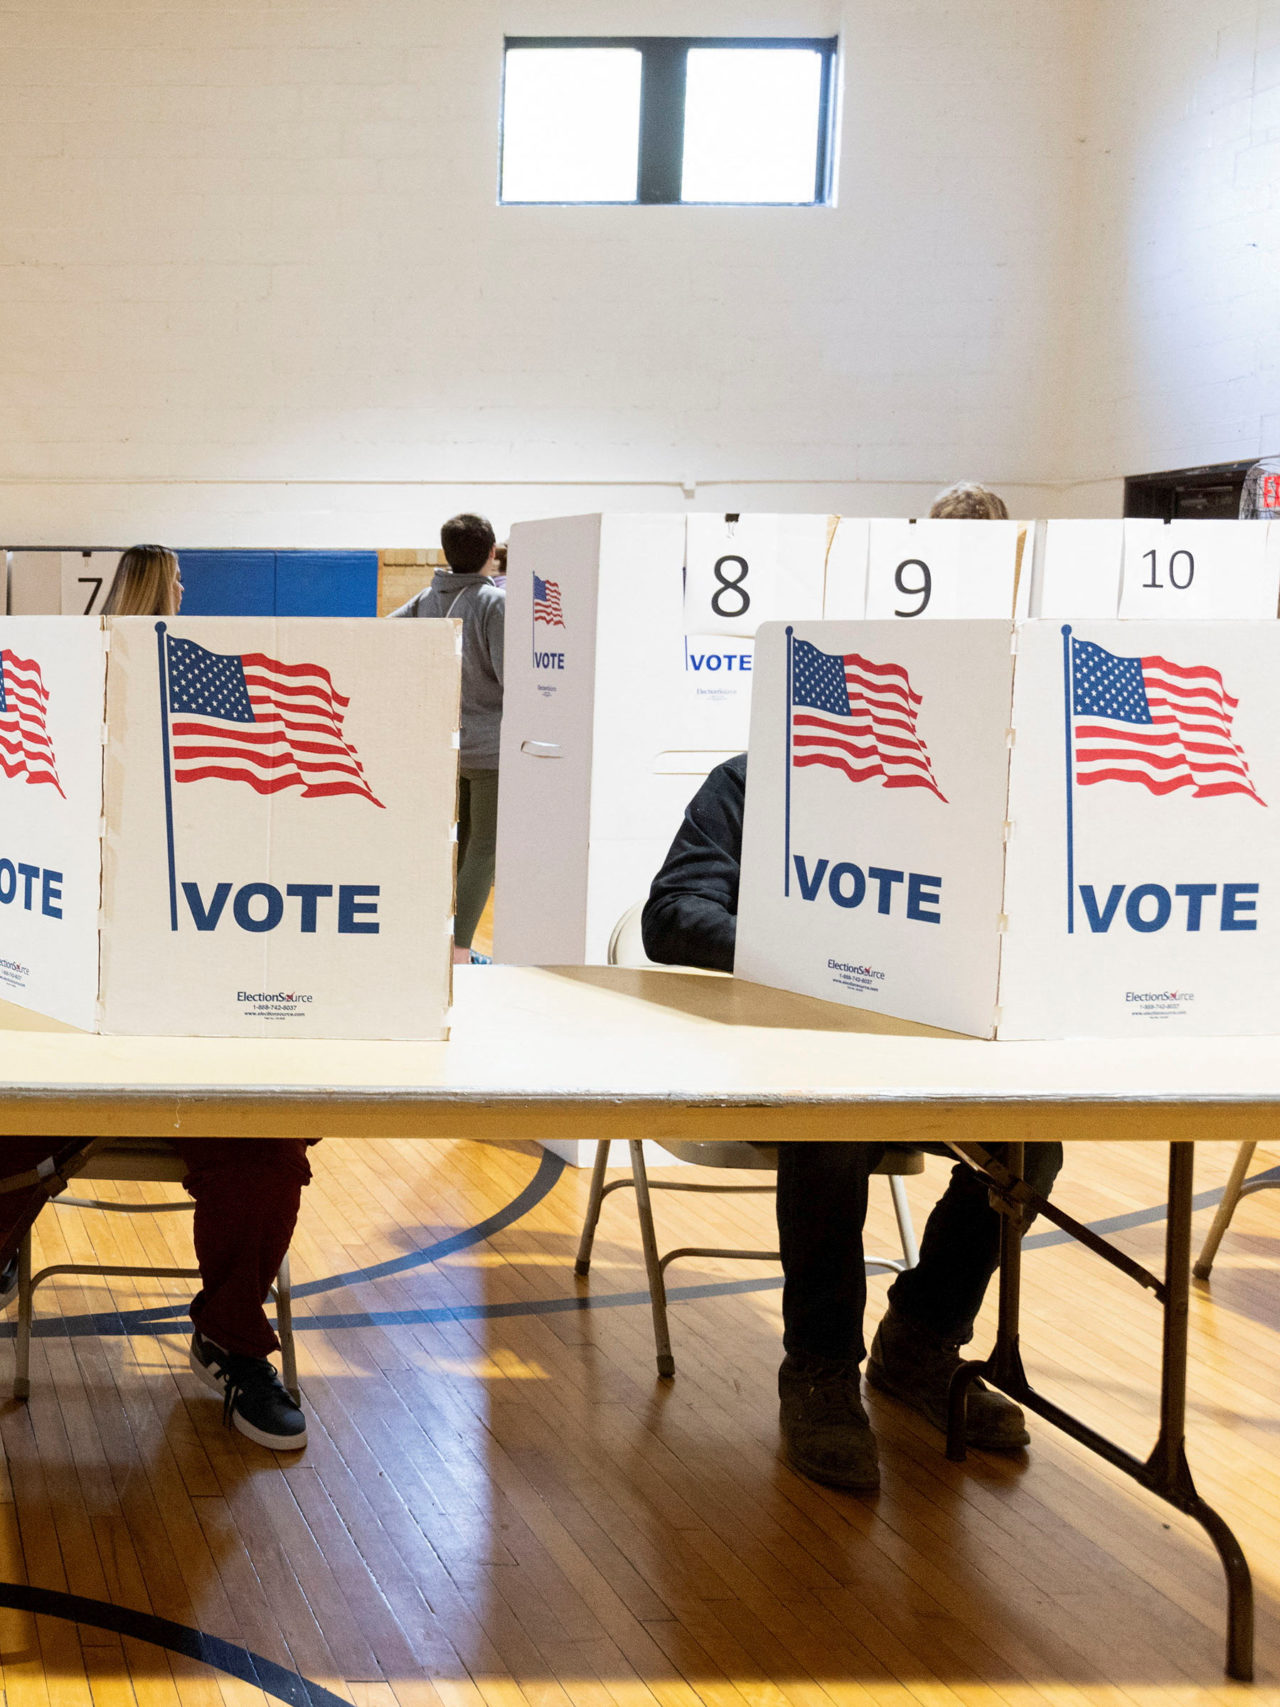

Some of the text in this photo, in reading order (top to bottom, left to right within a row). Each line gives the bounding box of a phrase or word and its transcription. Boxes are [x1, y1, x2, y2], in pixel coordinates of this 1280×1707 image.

[711, 555, 751, 618] 8
[894, 558, 932, 618] 9
[1142, 549, 1195, 589] 10
[78, 577, 103, 615] 7
[535, 652, 565, 669] VOTE
[689, 654, 753, 671] VOTE
[181, 882, 381, 934] VOTE
[792, 854, 943, 925] VOTE
[1079, 882, 1260, 934] VOTE
[827, 958, 886, 980] ElectionSource
[237, 991, 313, 1003] ElectionSource
[1125, 990, 1195, 1002] ElectionSource
